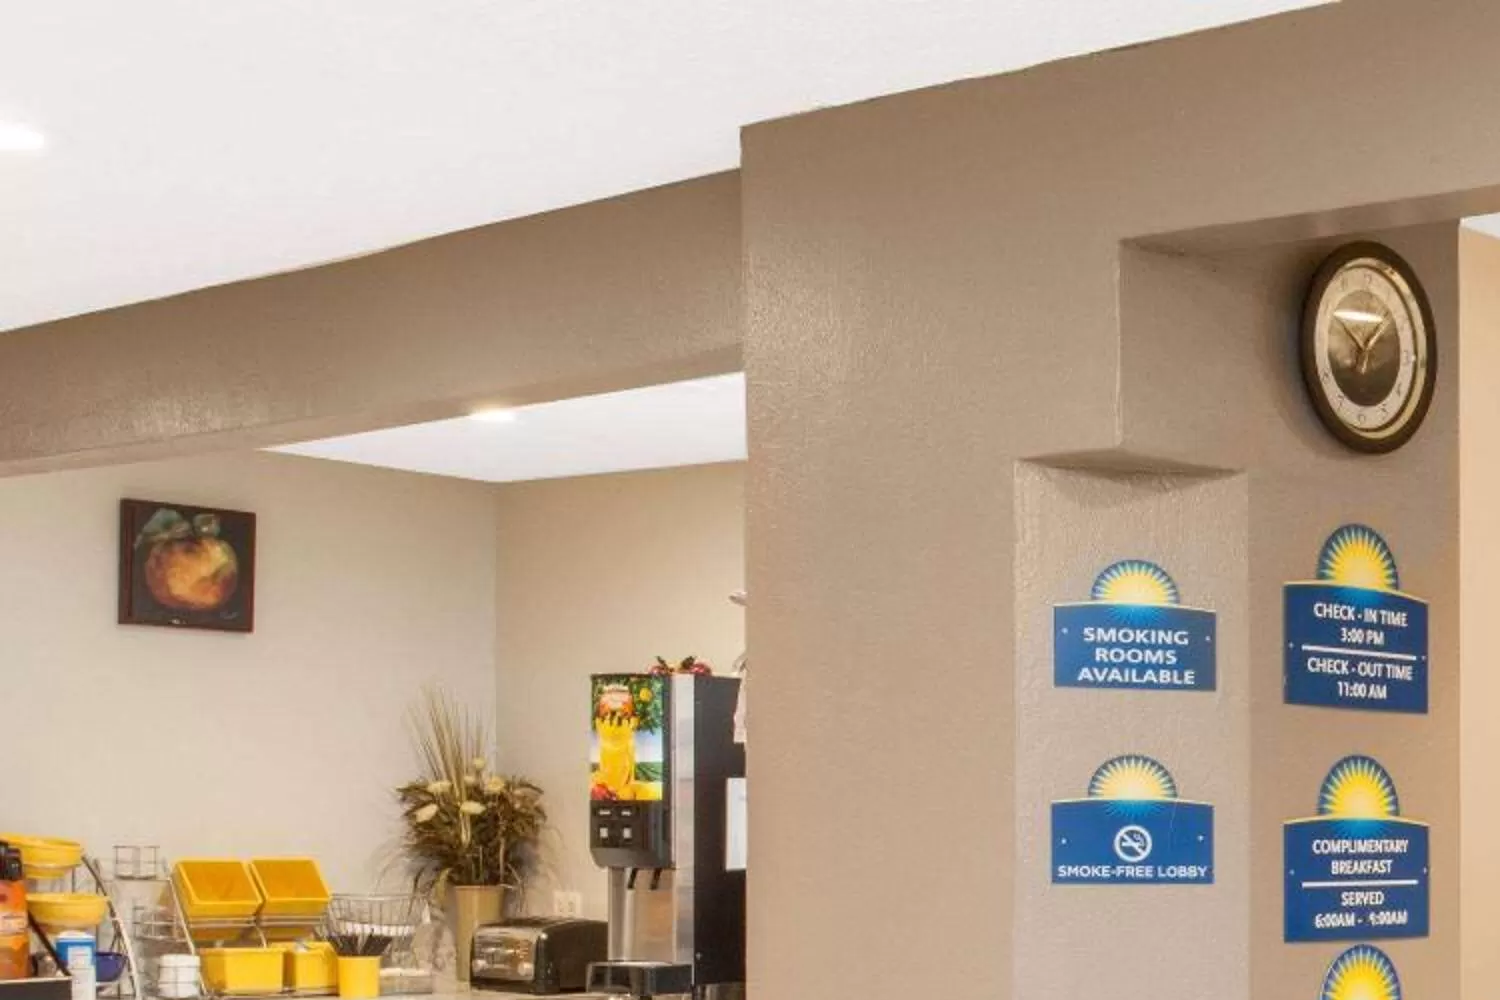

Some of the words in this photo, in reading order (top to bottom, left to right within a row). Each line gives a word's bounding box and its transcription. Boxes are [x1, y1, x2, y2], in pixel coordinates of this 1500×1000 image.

[1313, 603, 1355, 621] CHECK
[1364, 607, 1377, 625] IN
[1379, 609, 1408, 627] TIME
[1083, 627, 1189, 645] SMOKING
[1340, 627, 1365, 643] 3:00
[1366, 629, 1385, 645] PM
[1095, 647, 1177, 665] ROOMS
[1077, 667, 1195, 685] AVAILABLE
[1307, 657, 1349, 676] CHECK
[1358, 661, 1384, 678] OUT
[1386, 663, 1413, 681] TIME
[1337, 681, 1367, 698] 11:00
[1368, 683, 1387, 700] AM
[1312, 839, 1409, 854] COMPLIMENTARY
[1058, 865, 1153, 878] SMOKE-FREE
[1157, 865, 1208, 878] LOBBY
[1331, 859, 1393, 875] BREAKFAST
[1340, 891, 1385, 907] SERVED
